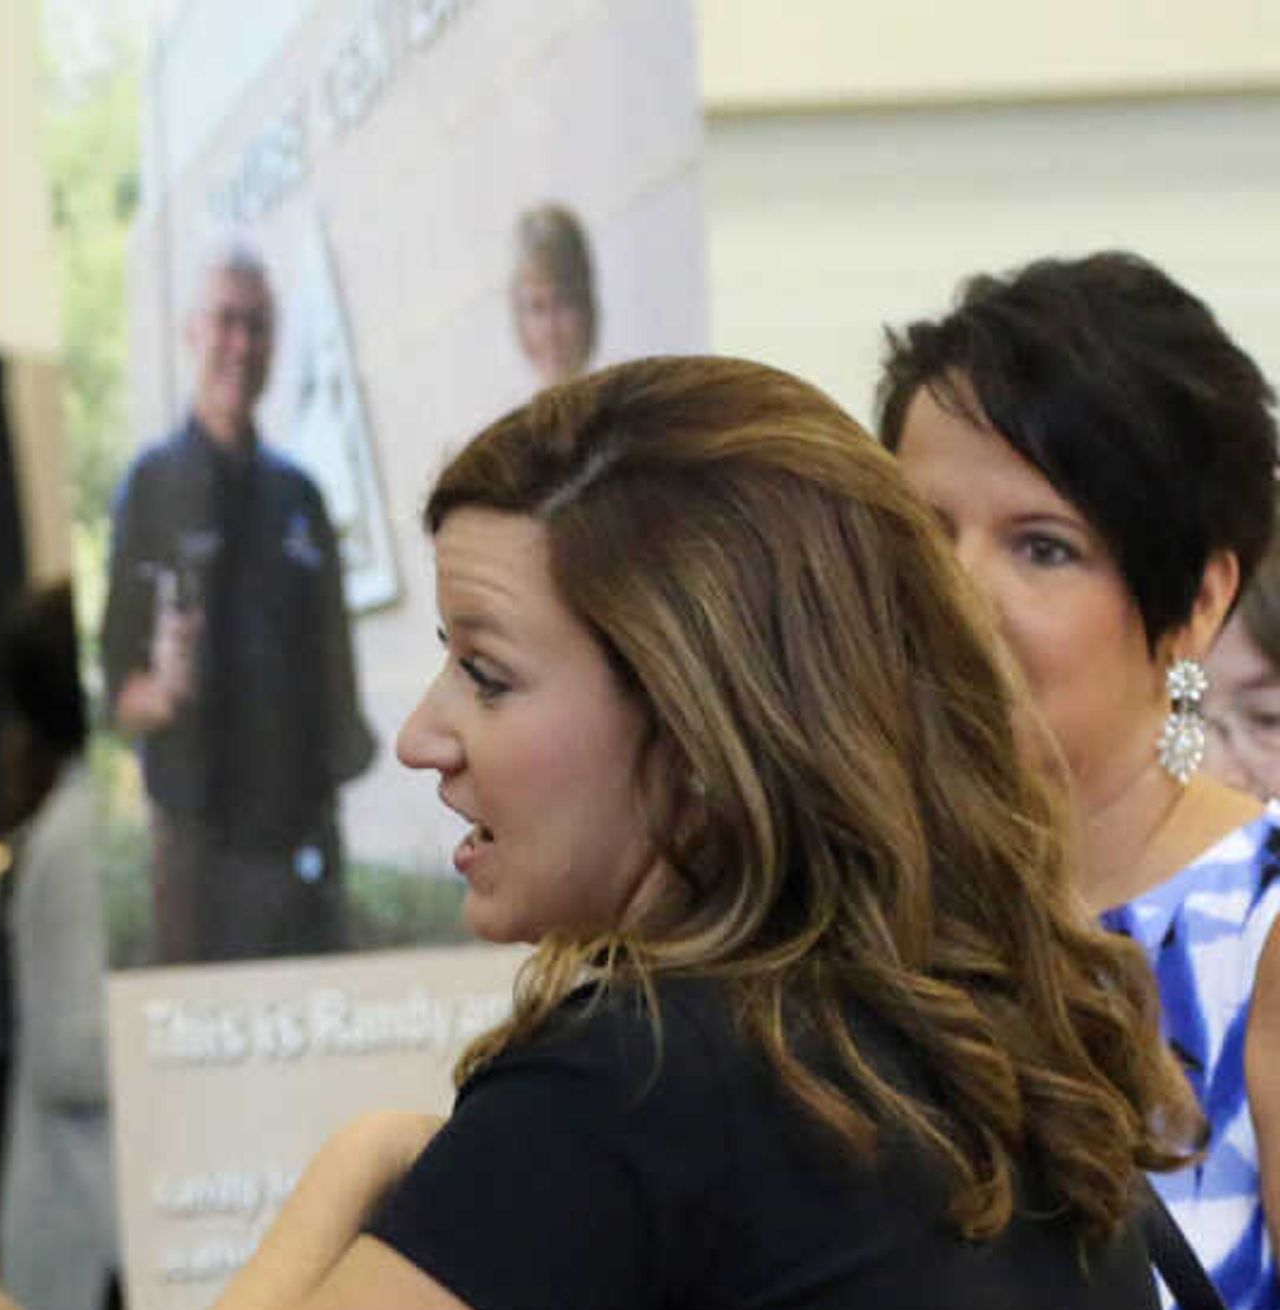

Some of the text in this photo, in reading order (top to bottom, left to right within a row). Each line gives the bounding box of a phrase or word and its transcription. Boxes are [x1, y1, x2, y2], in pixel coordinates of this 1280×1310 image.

[145, 1000, 246, 1064] This
[254, 1003, 306, 1060] is
[314, 988, 450, 1060] Randy
